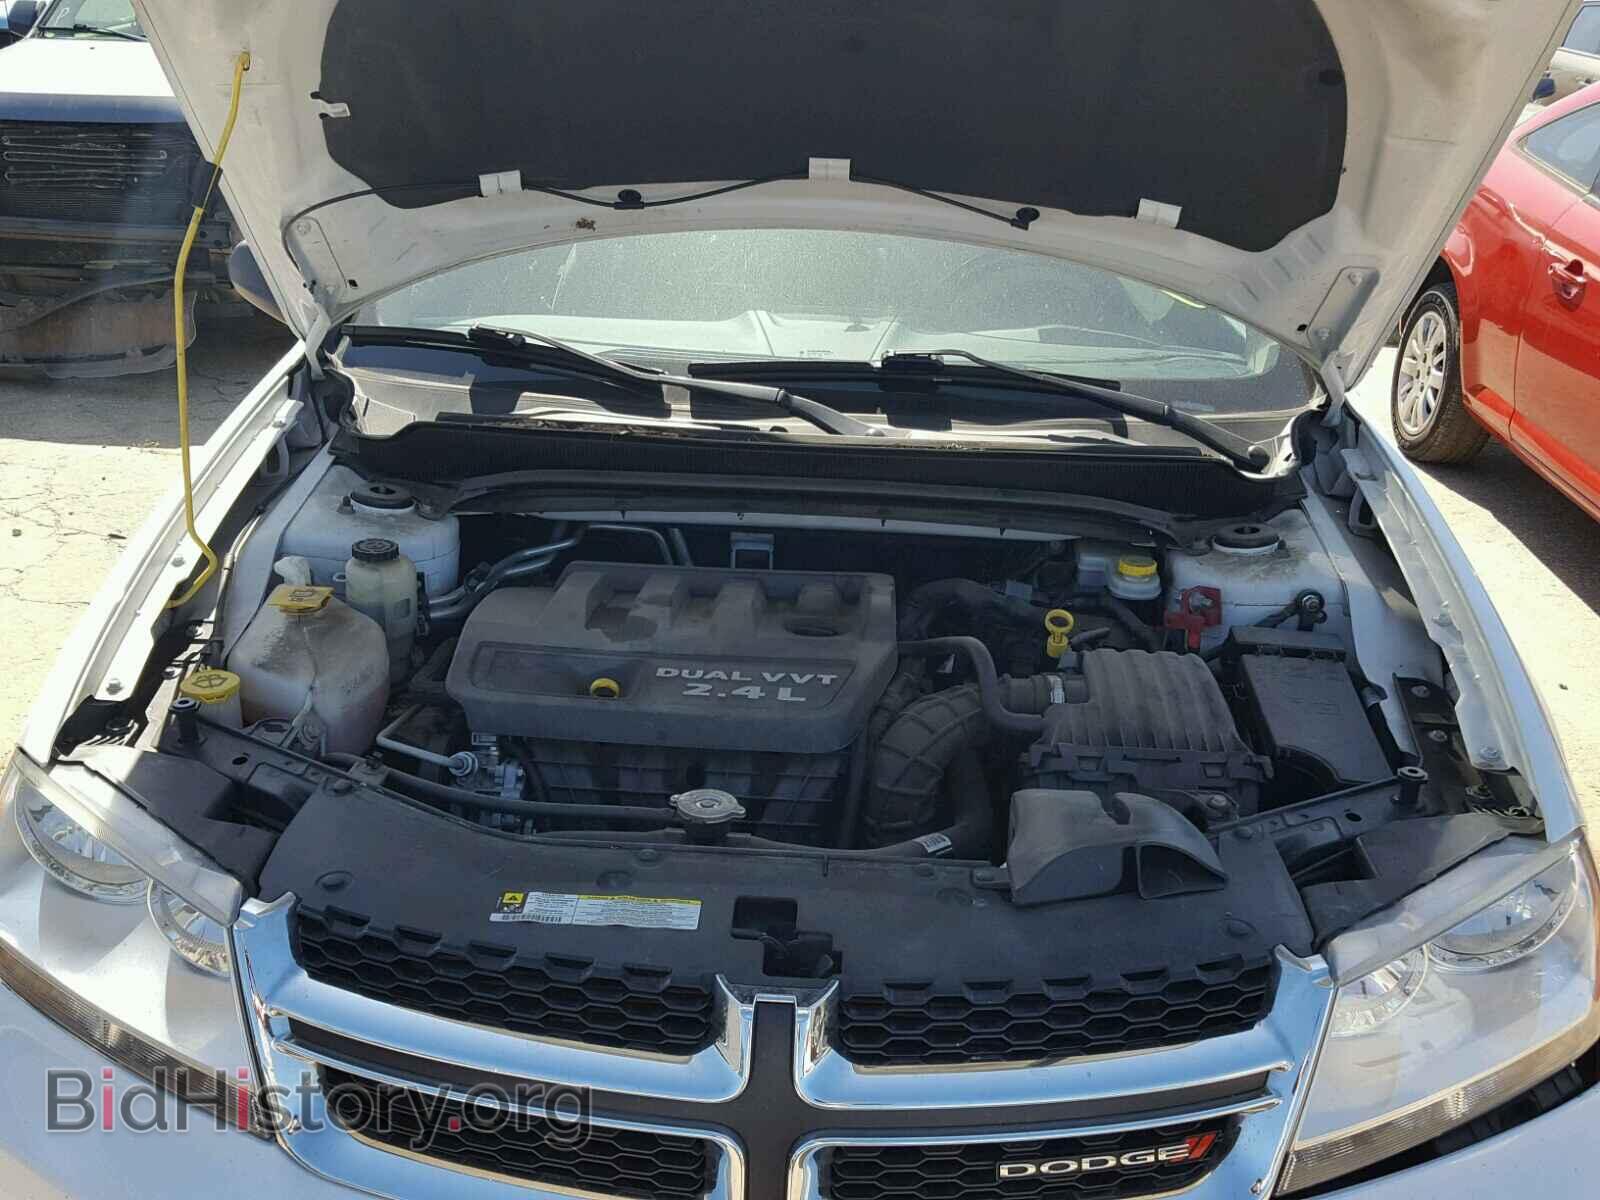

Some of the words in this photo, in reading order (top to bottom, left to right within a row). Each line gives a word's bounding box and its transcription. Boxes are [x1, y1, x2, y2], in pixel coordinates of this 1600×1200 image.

[656, 667, 752, 681] DUAL
[761, 672, 838, 685] VVT
[999, 1143, 1190, 1178] DODGE
